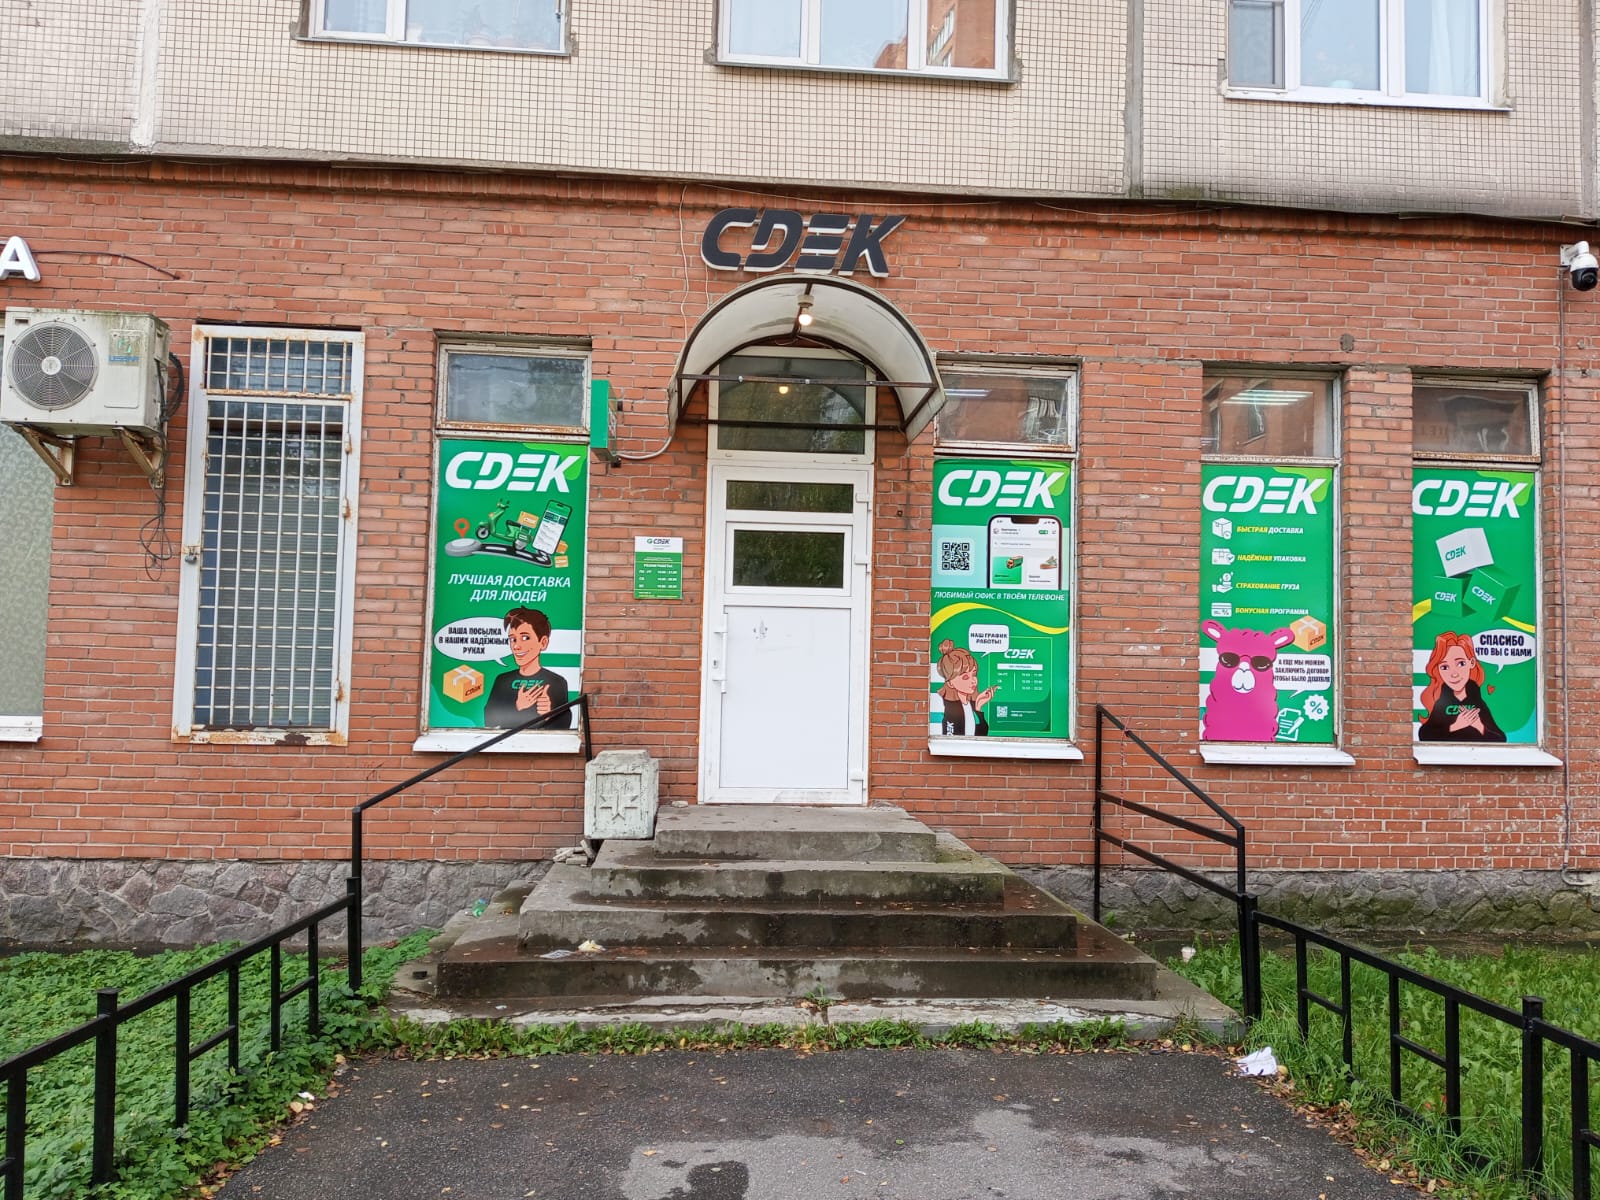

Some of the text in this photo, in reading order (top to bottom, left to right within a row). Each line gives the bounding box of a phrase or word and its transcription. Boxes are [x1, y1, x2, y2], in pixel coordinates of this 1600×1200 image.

[701, 208, 907, 277] CDEK
[445, 451, 581, 493] CDEK
[938, 469, 1064, 509] CDEK
[1202, 475, 1327, 514] CDEK
[1412, 479, 1528, 518] CDEK
[1268, 527, 1304, 535] ДОСТАВКА
[1445, 545, 1466, 561] CDEK
[448, 573, 571, 588] ЛУЧШАЯ ДОСТАВКА
[1235, 582, 1281, 590] СТРАХОВАНИЕ
[470, 589, 547, 603] ДЛЯ ЛЮДЕЙ
[934, 591, 974, 599] ЛЮБИМЫЙ
[1003, 591, 1027, 600] ТВОЁМ
[1027, 593, 1065, 601] ТЕЛЕФОНЕ
[1434, 591, 1457, 602] CDEK
[1471, 586, 1496, 605] CDEK
[448, 627, 502, 636] ВАША ПОСЫЛКА
[438, 636, 444, 644] В
[1480, 634, 1525, 646] СПАСИБО
[462, 646, 486, 655] РУКАХ
[1004, 648, 1036, 659] CDEK
[1475, 647, 1532, 657] ЧТО ВЫ С НАМИ
